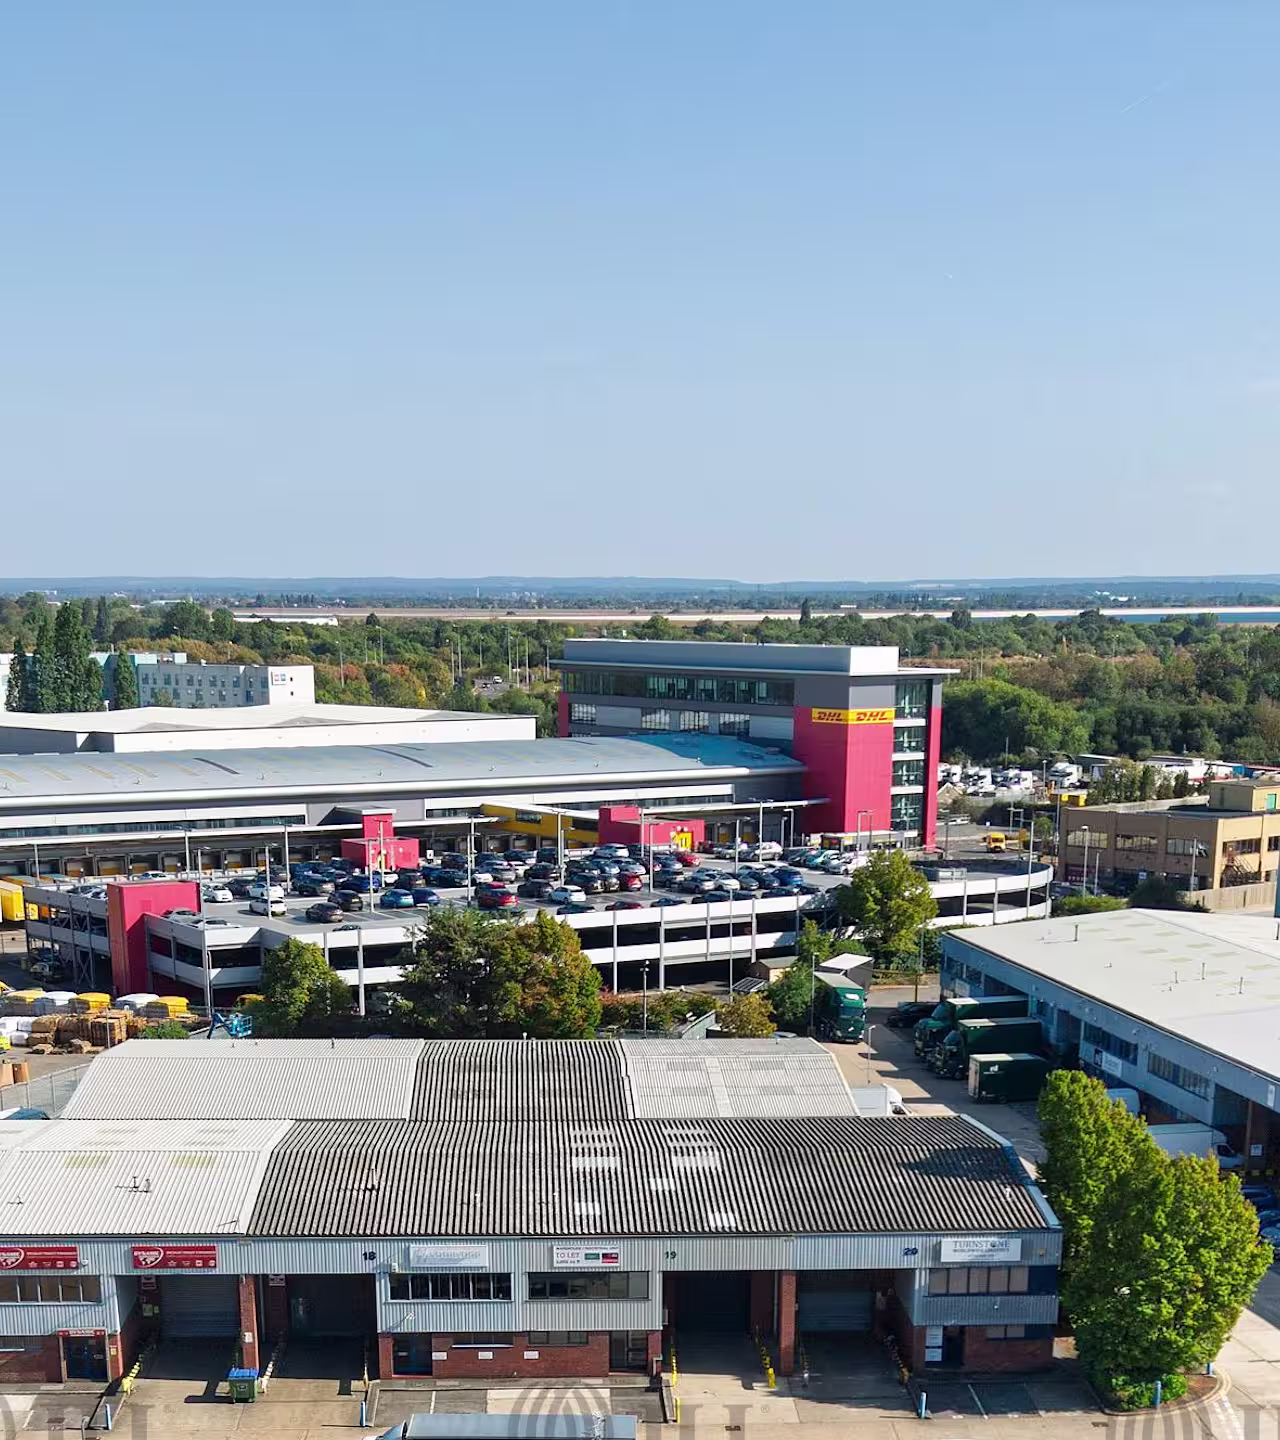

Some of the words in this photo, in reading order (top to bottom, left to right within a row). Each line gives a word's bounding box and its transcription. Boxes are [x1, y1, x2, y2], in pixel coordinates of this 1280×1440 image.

[816, 711, 843, 721] DHL
[856, 711, 889, 721] DHL
[363, 1251, 377, 1260] 18
[665, 1251, 676, 1259] 19
[903, 1247, 918, 1256] 20
